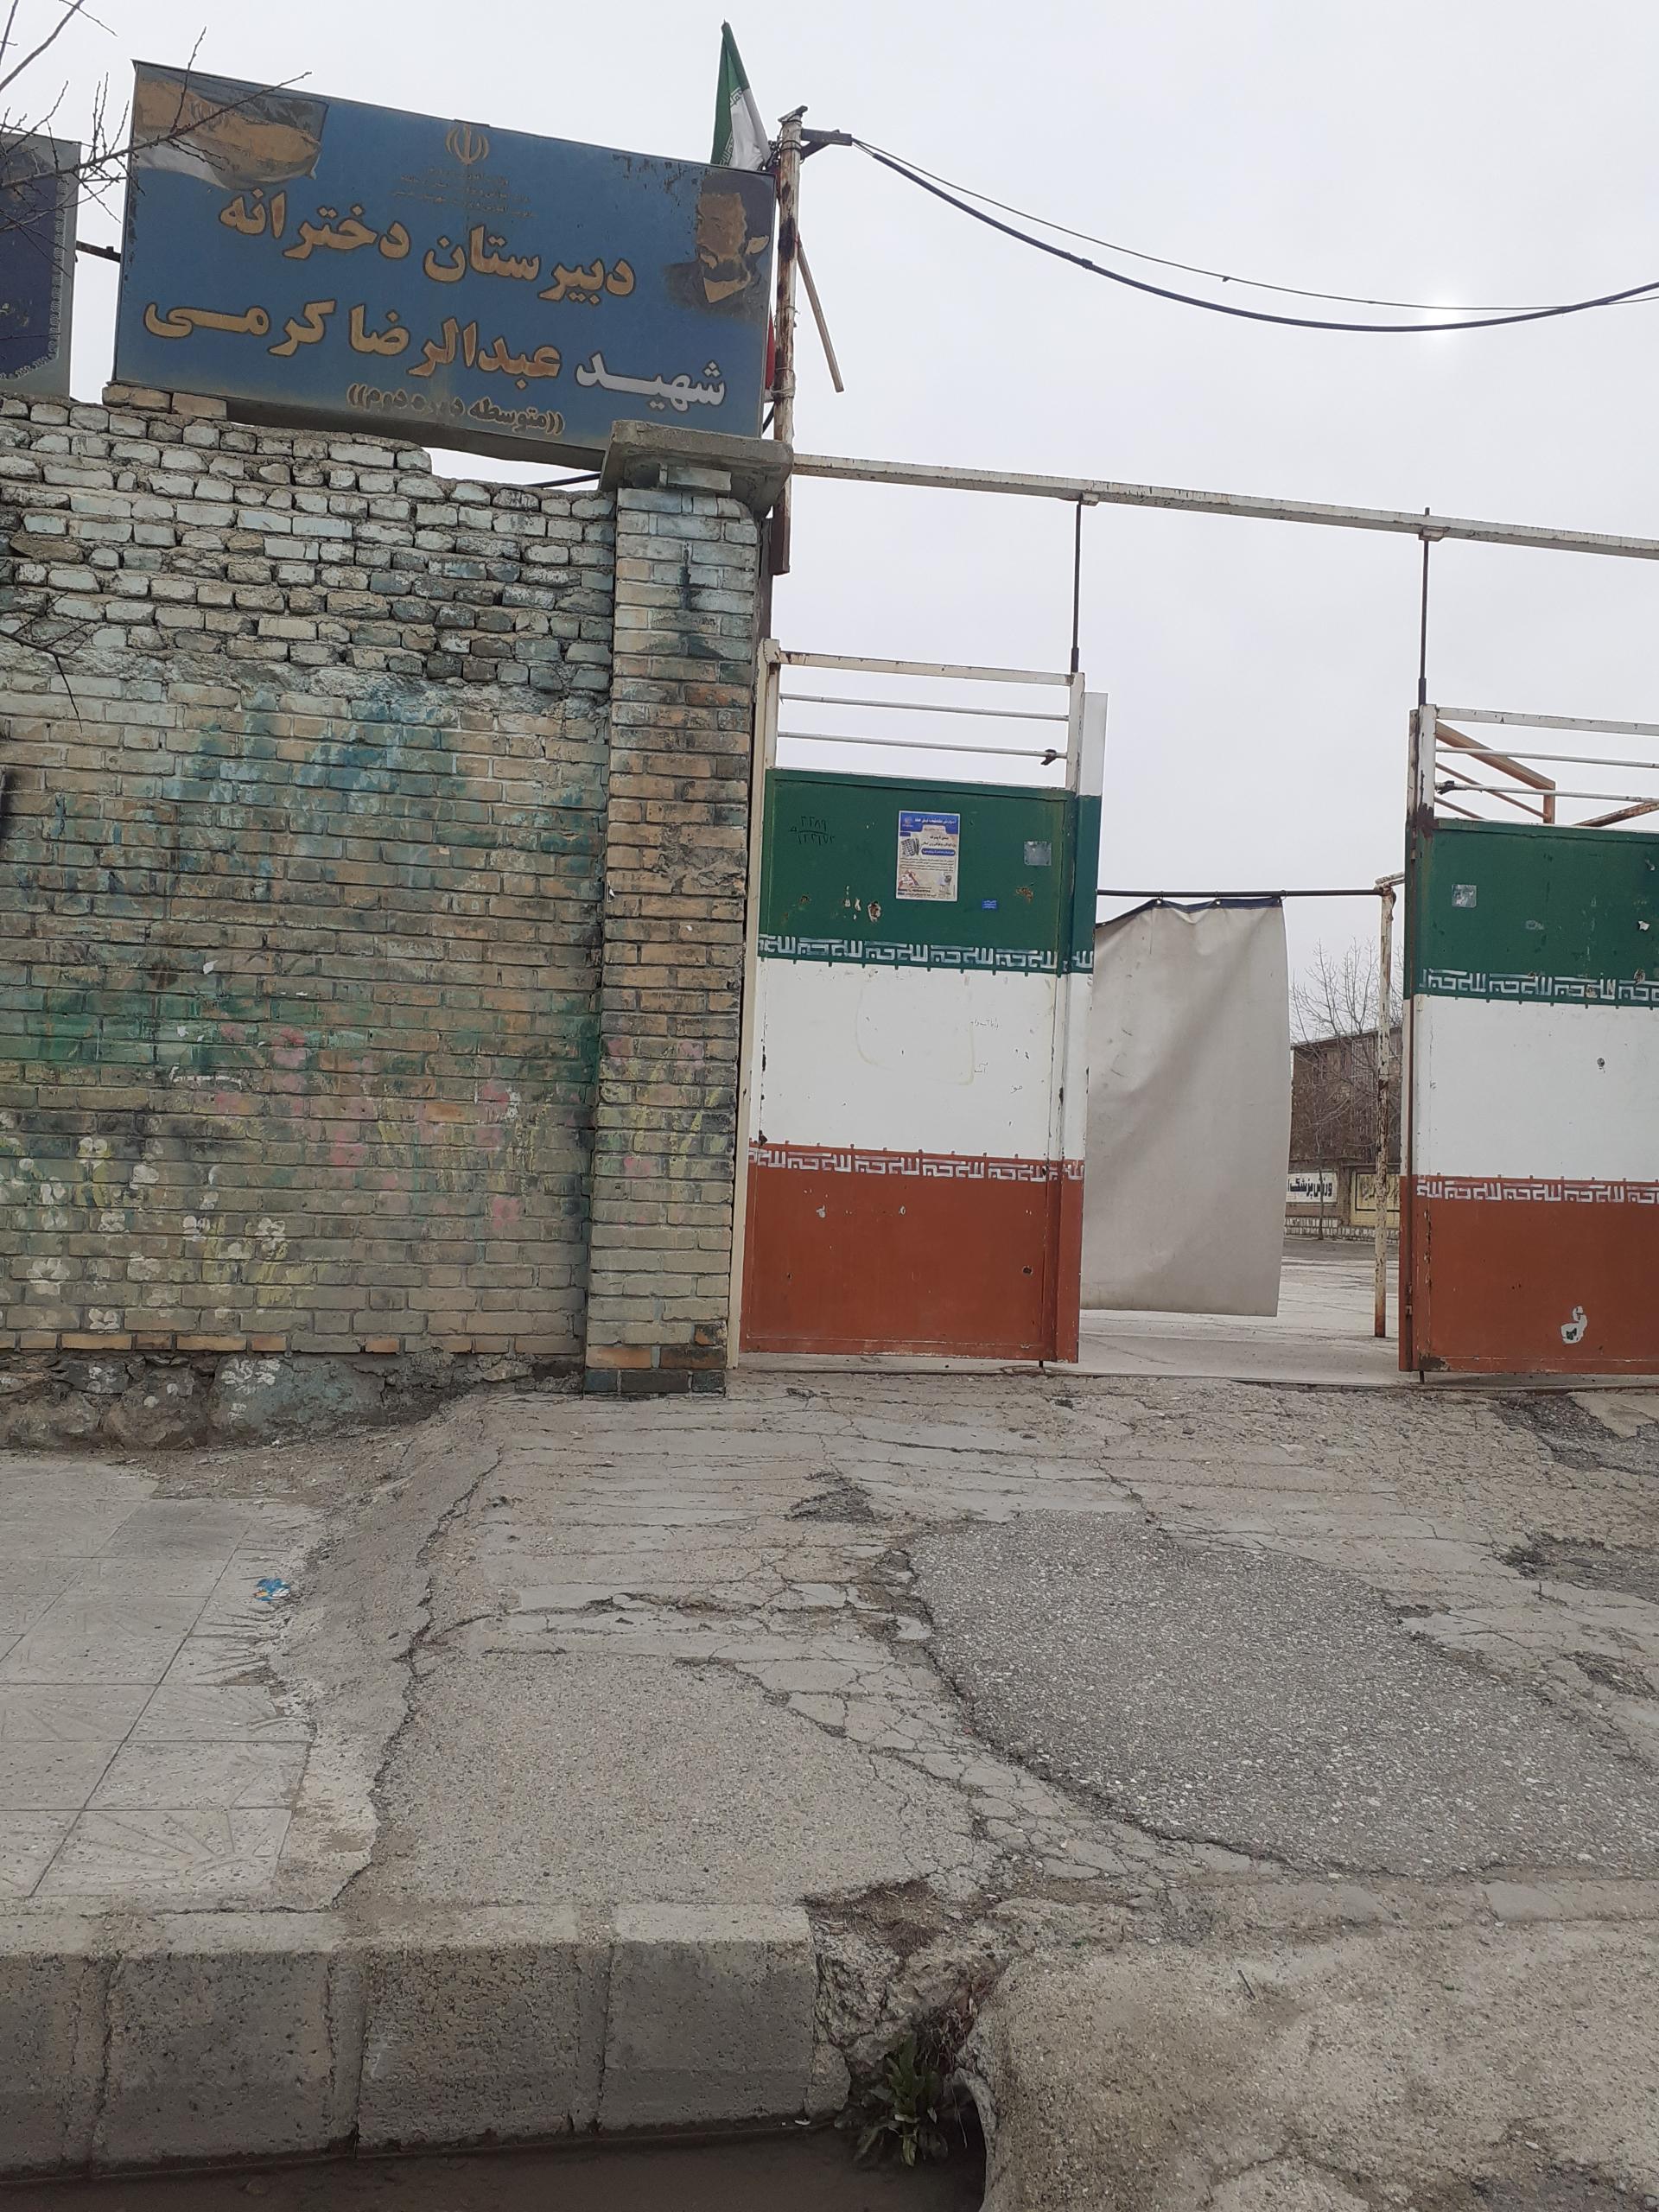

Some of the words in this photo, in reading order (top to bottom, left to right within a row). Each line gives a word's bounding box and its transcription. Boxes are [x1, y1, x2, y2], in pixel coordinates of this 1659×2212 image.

[219, 188, 411, 260] دخترانه
[423, 225, 636, 305] دبیرستان
[143, 299, 336, 357] کرمی
[574, 352, 727, 413] شهید
